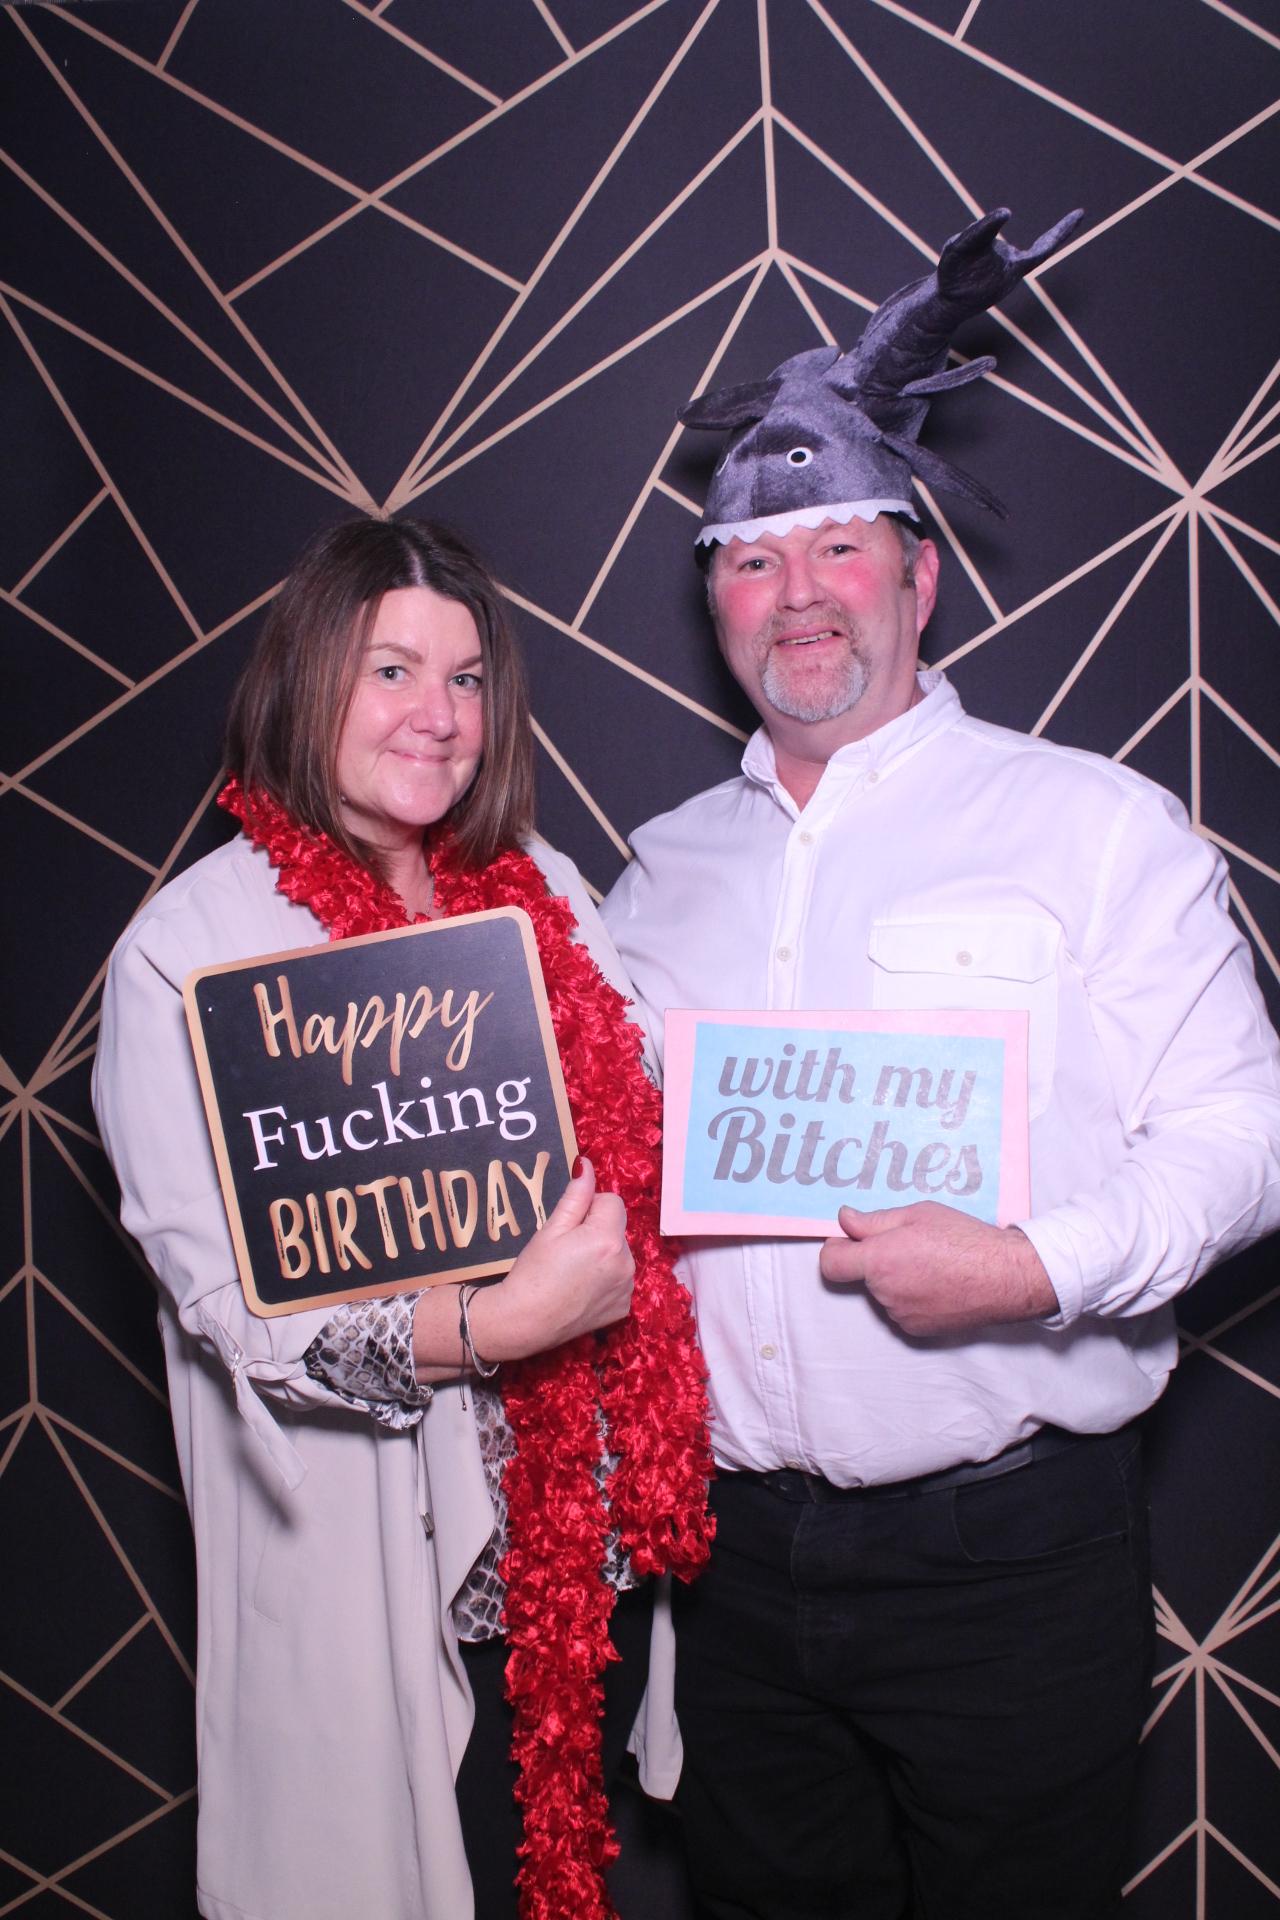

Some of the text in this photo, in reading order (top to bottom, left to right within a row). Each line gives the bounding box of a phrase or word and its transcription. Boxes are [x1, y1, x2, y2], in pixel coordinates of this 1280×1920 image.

[253, 975, 494, 1085] Happy
[242, 1077, 537, 1171] Fucking
[718, 1043, 977, 1130] with my
[707, 1106, 983, 1196] Bitches
[269, 1151, 551, 1279] BIRTHDAY
